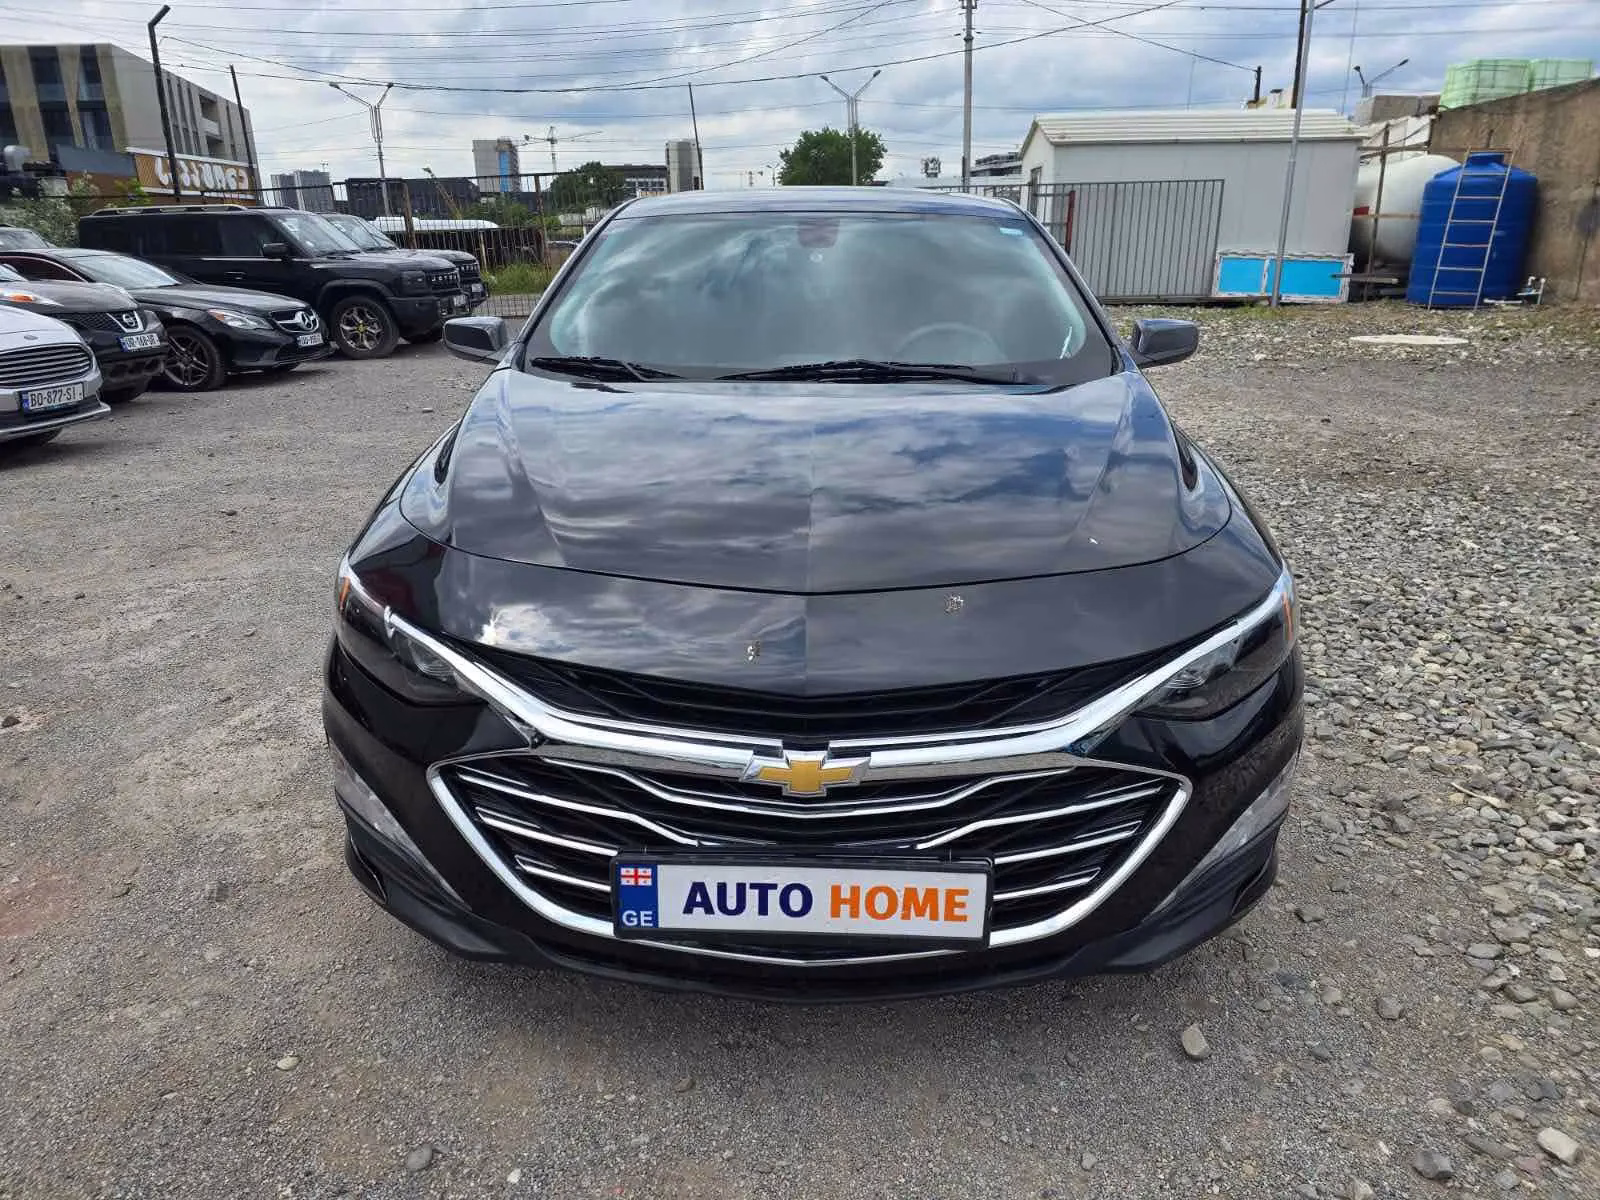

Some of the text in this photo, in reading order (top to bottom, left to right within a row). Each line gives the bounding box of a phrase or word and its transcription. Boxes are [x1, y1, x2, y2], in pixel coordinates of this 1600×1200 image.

[682, 881, 968, 922] AUTO HOME
[622, 910, 653, 927] GE
